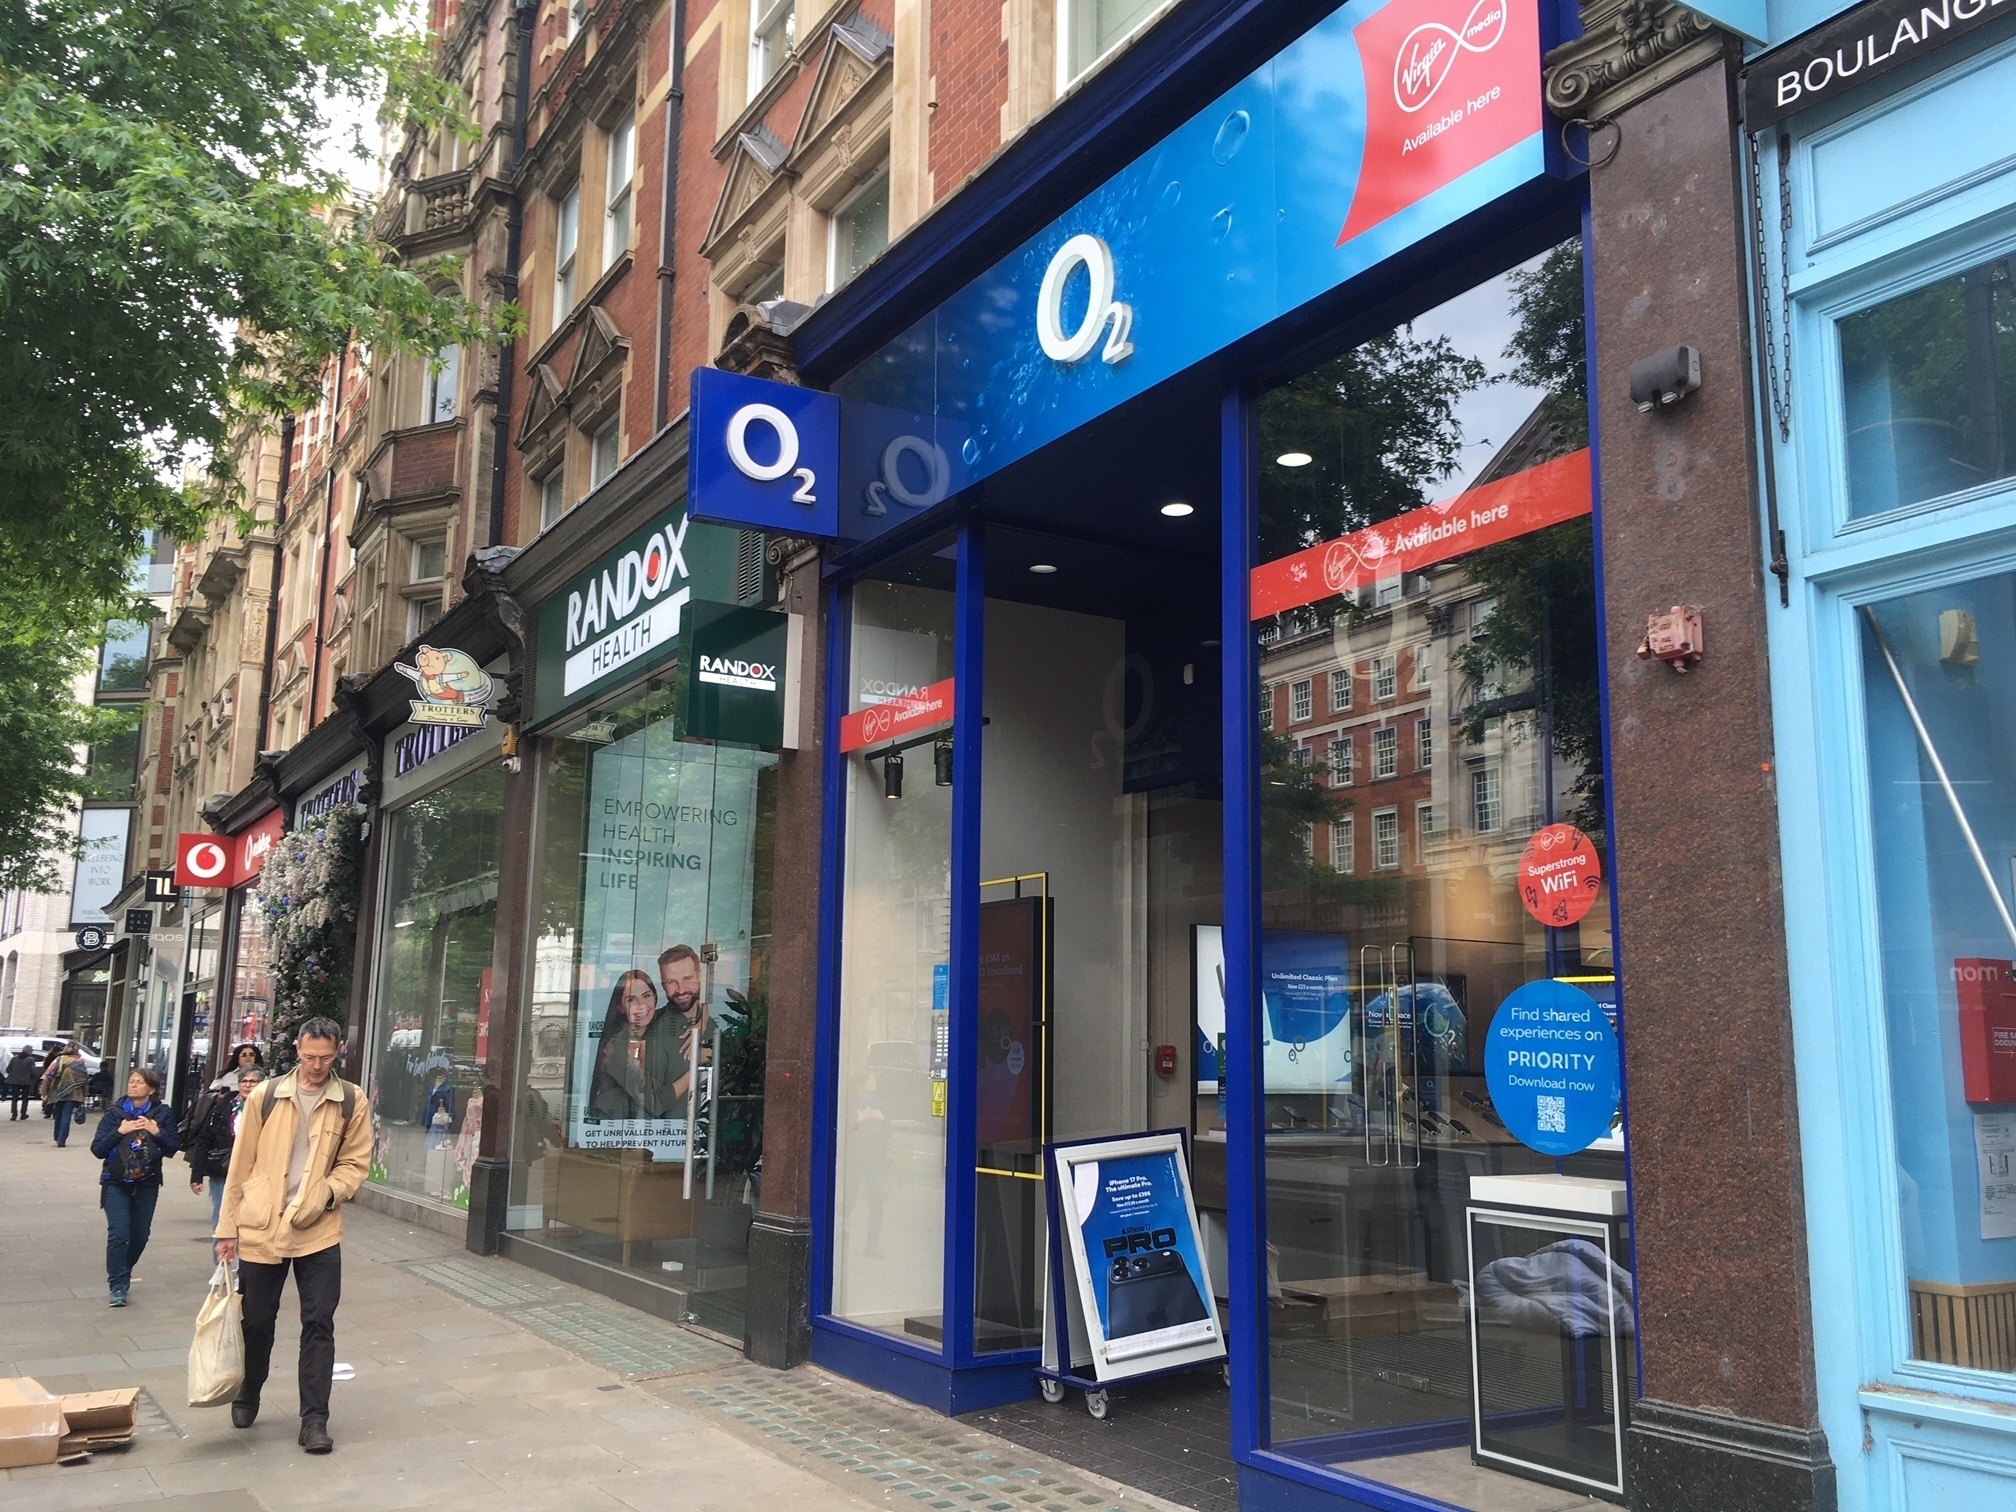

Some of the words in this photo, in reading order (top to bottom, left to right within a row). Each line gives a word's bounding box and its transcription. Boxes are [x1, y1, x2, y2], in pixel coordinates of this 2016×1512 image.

[1467, 10, 1501, 38] media
[1776, 0, 2007, 107] BOULANG
[1402, 38, 1446, 95] Virgin
[1402, 109, 1464, 156] Available
[1467, 86, 1501, 115] here
[1394, 522, 1467, 555] Available
[1471, 503, 1508, 528] here
[566, 512, 690, 652] RANDOX
[592, 614, 652, 674] HEALTH
[700, 655, 776, 680] RANDOX
[720, 678, 756, 686] HEALTH
[420, 704, 476, 715] TROTTERS
[894, 701, 926, 723] Available
[926, 698, 942, 714] here
[604, 798, 738, 826] EMPOWERING
[603, 823, 680, 848] HEALTH,
[90, 866, 110, 874] INTO
[602, 848, 702, 870] INSPIRING
[1528, 854, 1586, 876] Superstrong
[88, 878, 110, 886] WORK
[600, 872, 638, 890] LIFE
[1541, 870, 1578, 894] WiFi
[1511, 1008, 1540, 1021] Find
[1543, 1008, 1590, 1022] shared
[1500, 1026, 1581, 1040] experiences
[1584, 1031, 1602, 1041] on
[1508, 1051, 1595, 1070] PRIORITY
[1508, 1074, 1566, 1090] Download
[1568, 1082, 1595, 1091] now
[585, 1130, 602, 1138] GET
[604, 1129, 653, 1137] UNRIVALLED
[600, 1140, 622, 1148] HELP
[622, 1140, 658, 1148] PREVENT
[1118, 1183, 1140, 1191] ultimate
[1127, 1226, 1144, 1234] iPhone
[1103, 1228, 1176, 1258] PRO
